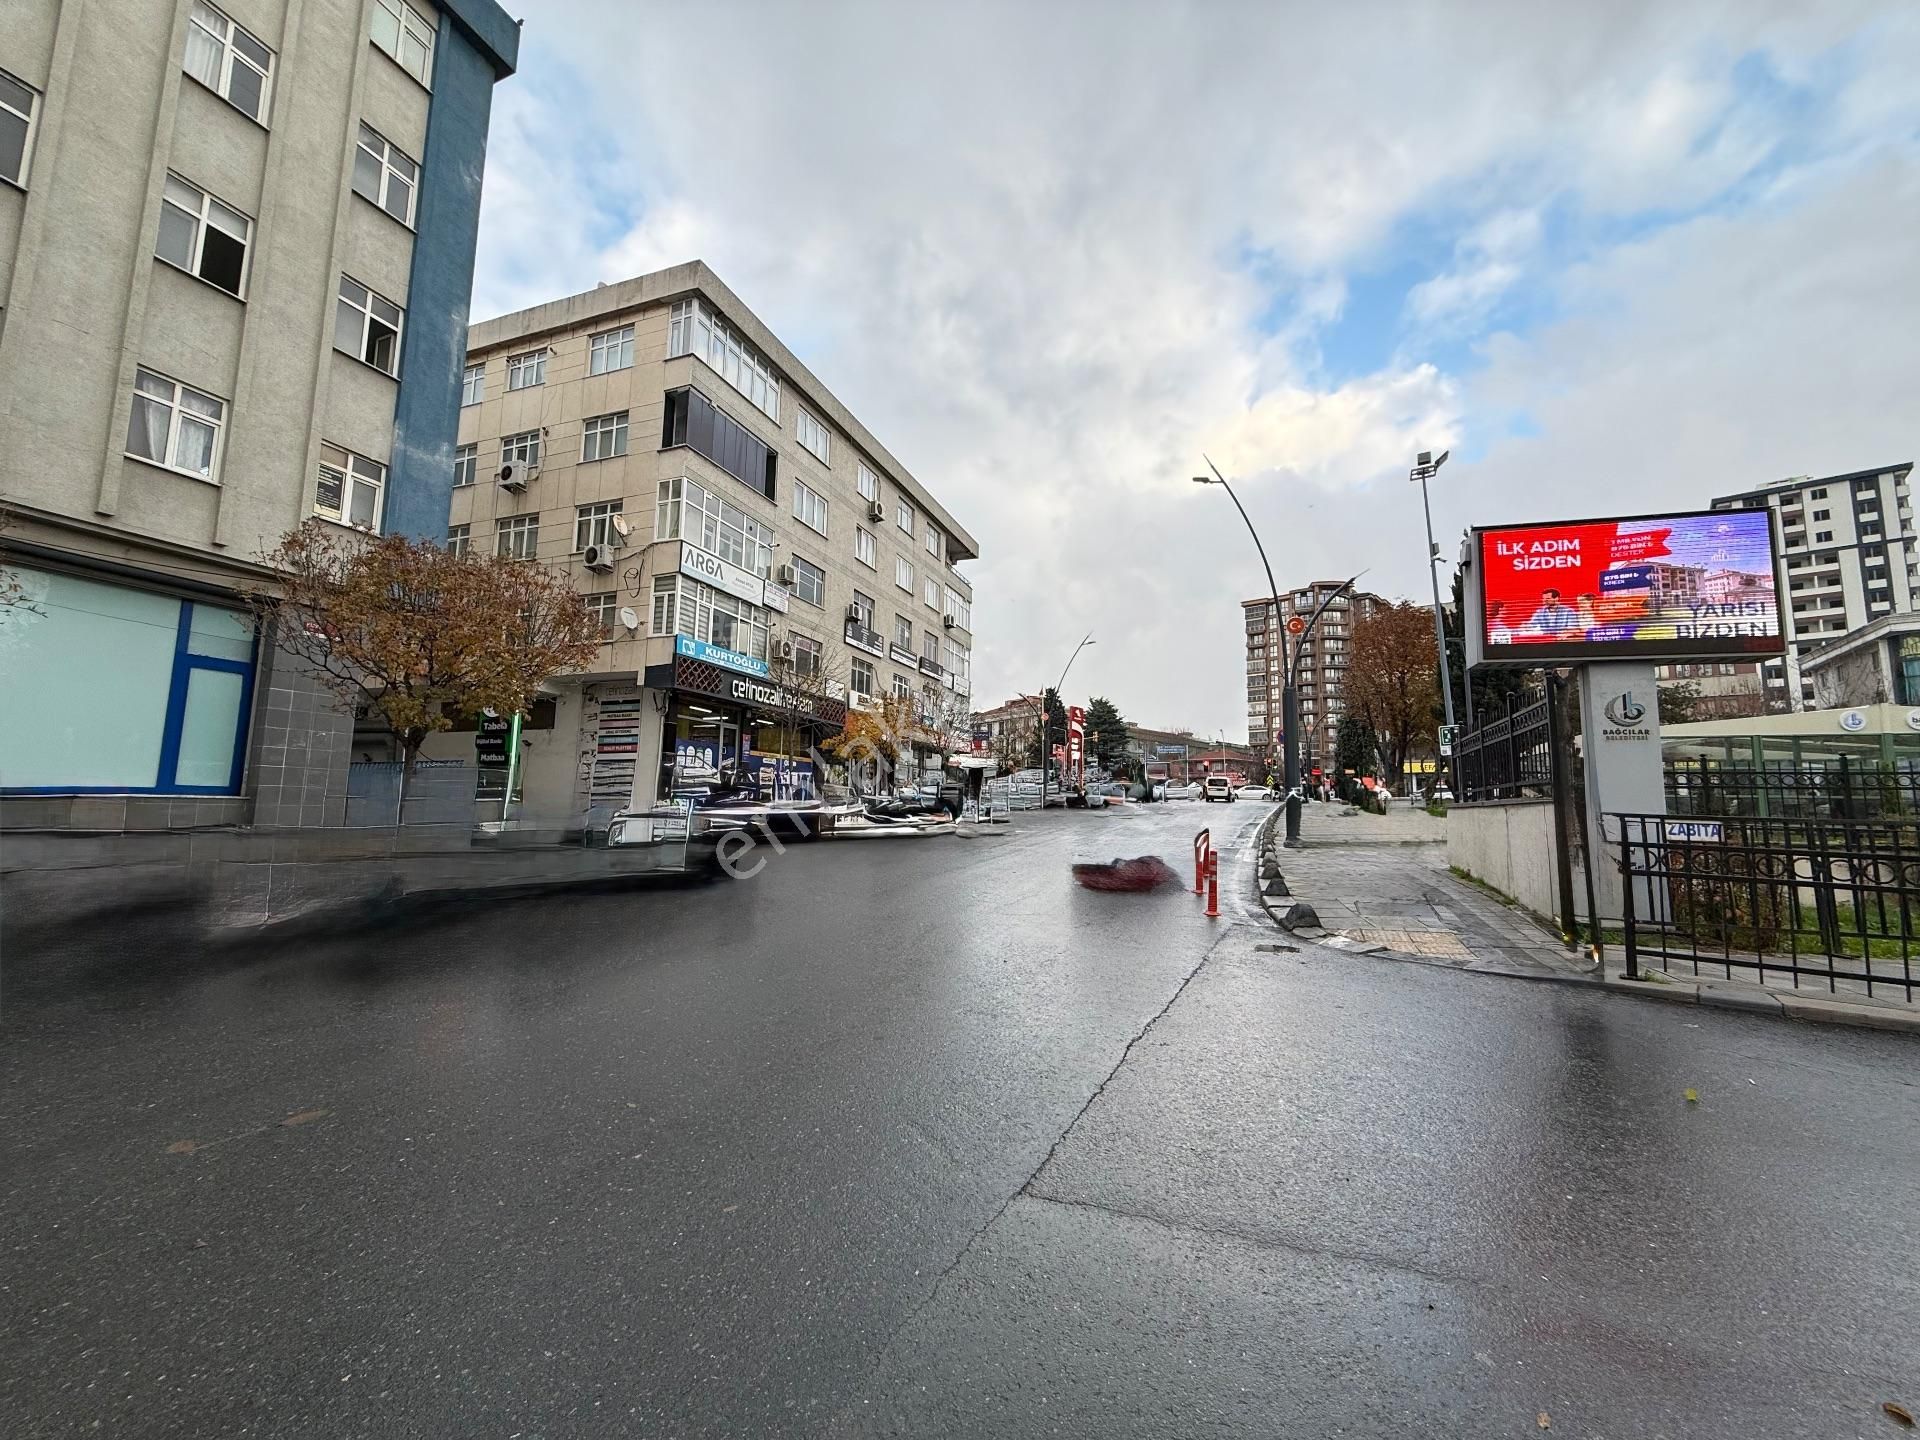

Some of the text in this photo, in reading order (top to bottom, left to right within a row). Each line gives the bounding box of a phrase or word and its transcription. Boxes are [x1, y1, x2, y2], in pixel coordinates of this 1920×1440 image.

[1497, 538, 1581, 556] İLK ADIM
[684, 548, 724, 581] ARGA
[1513, 554, 1581, 571] SİZDEN
[705, 646, 761, 670] KURTOĞLU
[1602, 728, 1650, 736] BAĞCILAR
[481, 753, 505, 761] Matbaa
[1668, 823, 1719, 837] ZABITA
